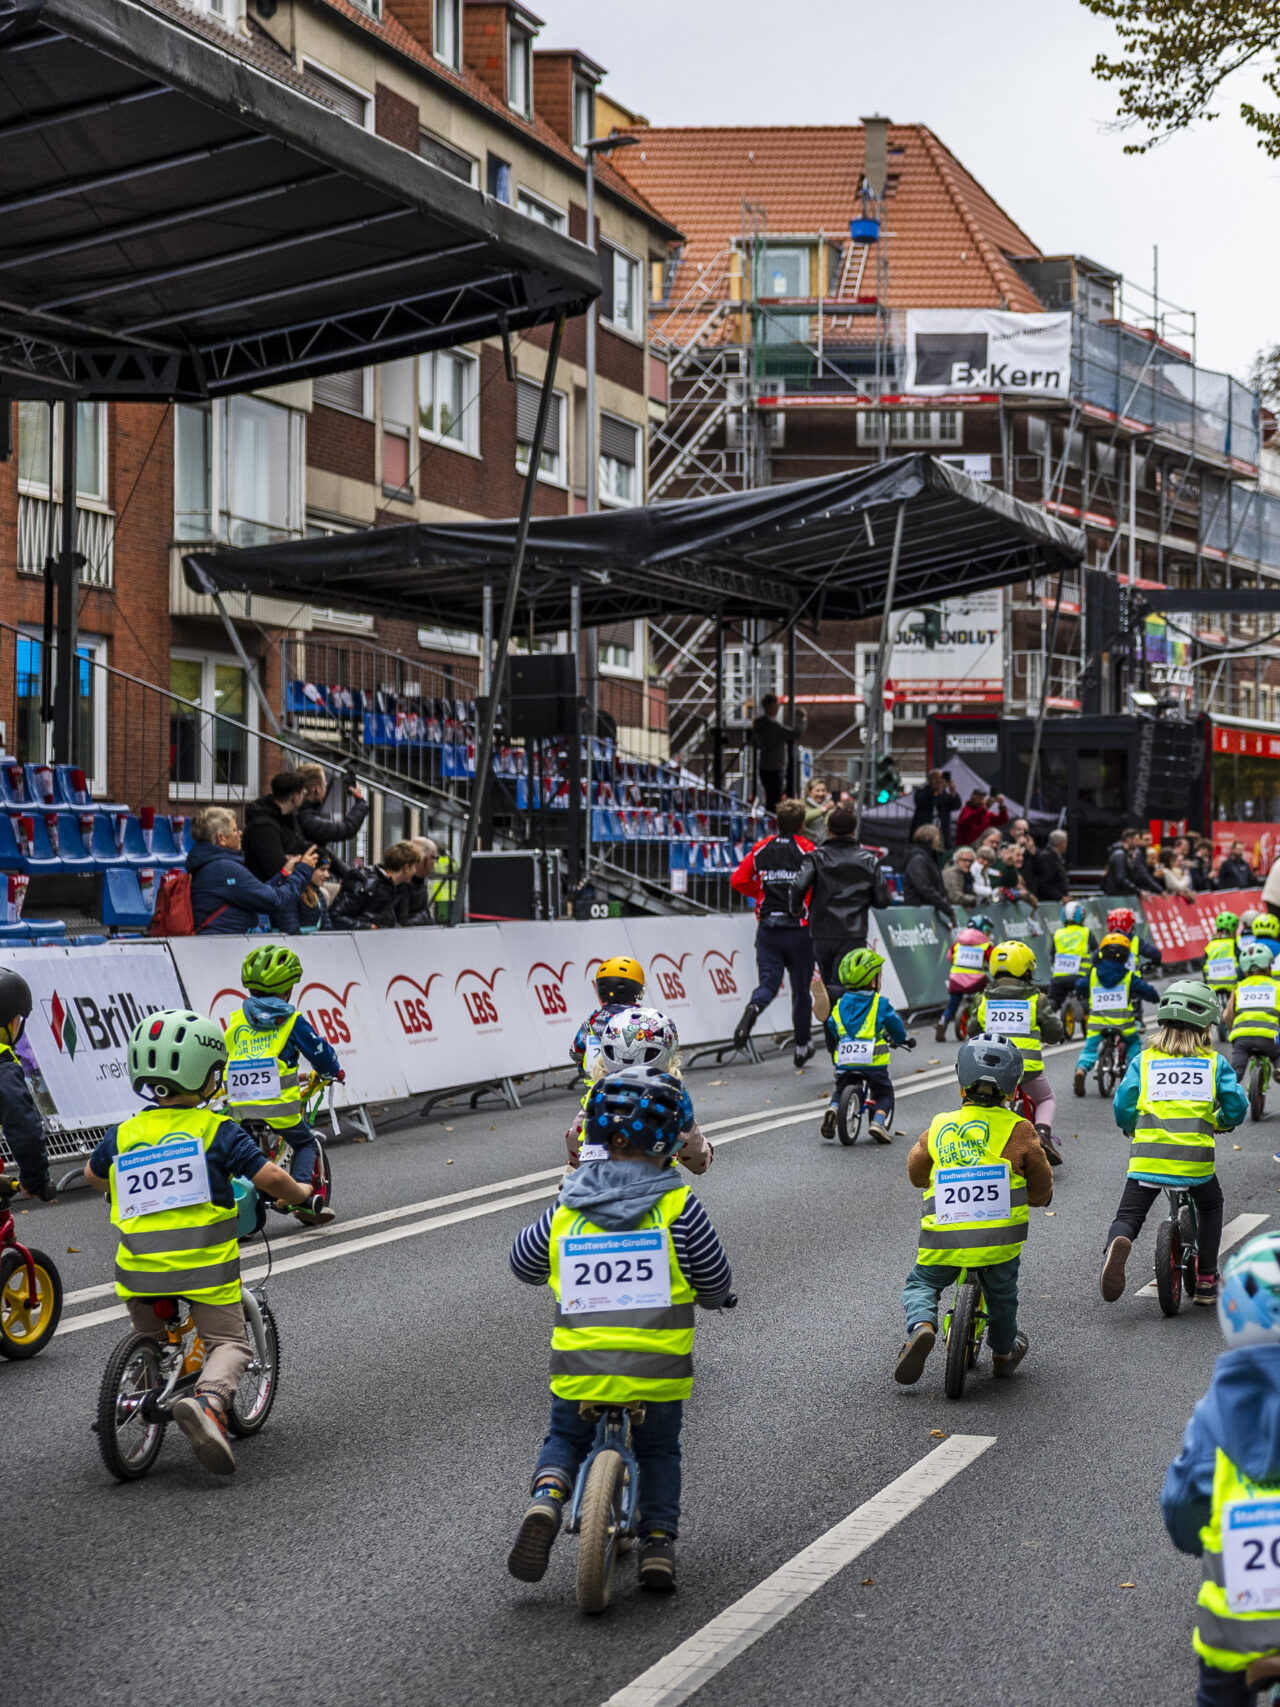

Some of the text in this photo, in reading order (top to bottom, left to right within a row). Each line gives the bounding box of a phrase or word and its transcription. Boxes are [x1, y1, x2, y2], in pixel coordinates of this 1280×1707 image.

[951, 361, 1061, 389] ExKern
[590, 904, 609, 918] 03
[656, 971, 686, 1000] LBS
[709, 967, 738, 996] LBS
[534, 983, 568, 1016] LBS
[1097, 993, 1122, 1002] 2025
[1243, 993, 1271, 1001] 2025
[393, 998, 433, 1035] LBS
[462, 990, 499, 1026] LBS
[990, 1011, 1025, 1022] 2025
[840, 1043, 868, 1055] 2025
[231, 1071, 271, 1087] 2025
[1156, 1071, 1204, 1085] 2025
[120, 1145, 195, 1168] Stadtwerke-Girolino
[938, 1141, 957, 1157] FÜR
[939, 1148, 986, 1167] FÜR DICH
[126, 1163, 194, 1195] 2025
[940, 1170, 1003, 1180] Stadtwerke-Girolino
[944, 1184, 1000, 1205] 2025
[567, 1237, 658, 1252] Stadtwerke-Girolino
[573, 1258, 654, 1286] 2025
